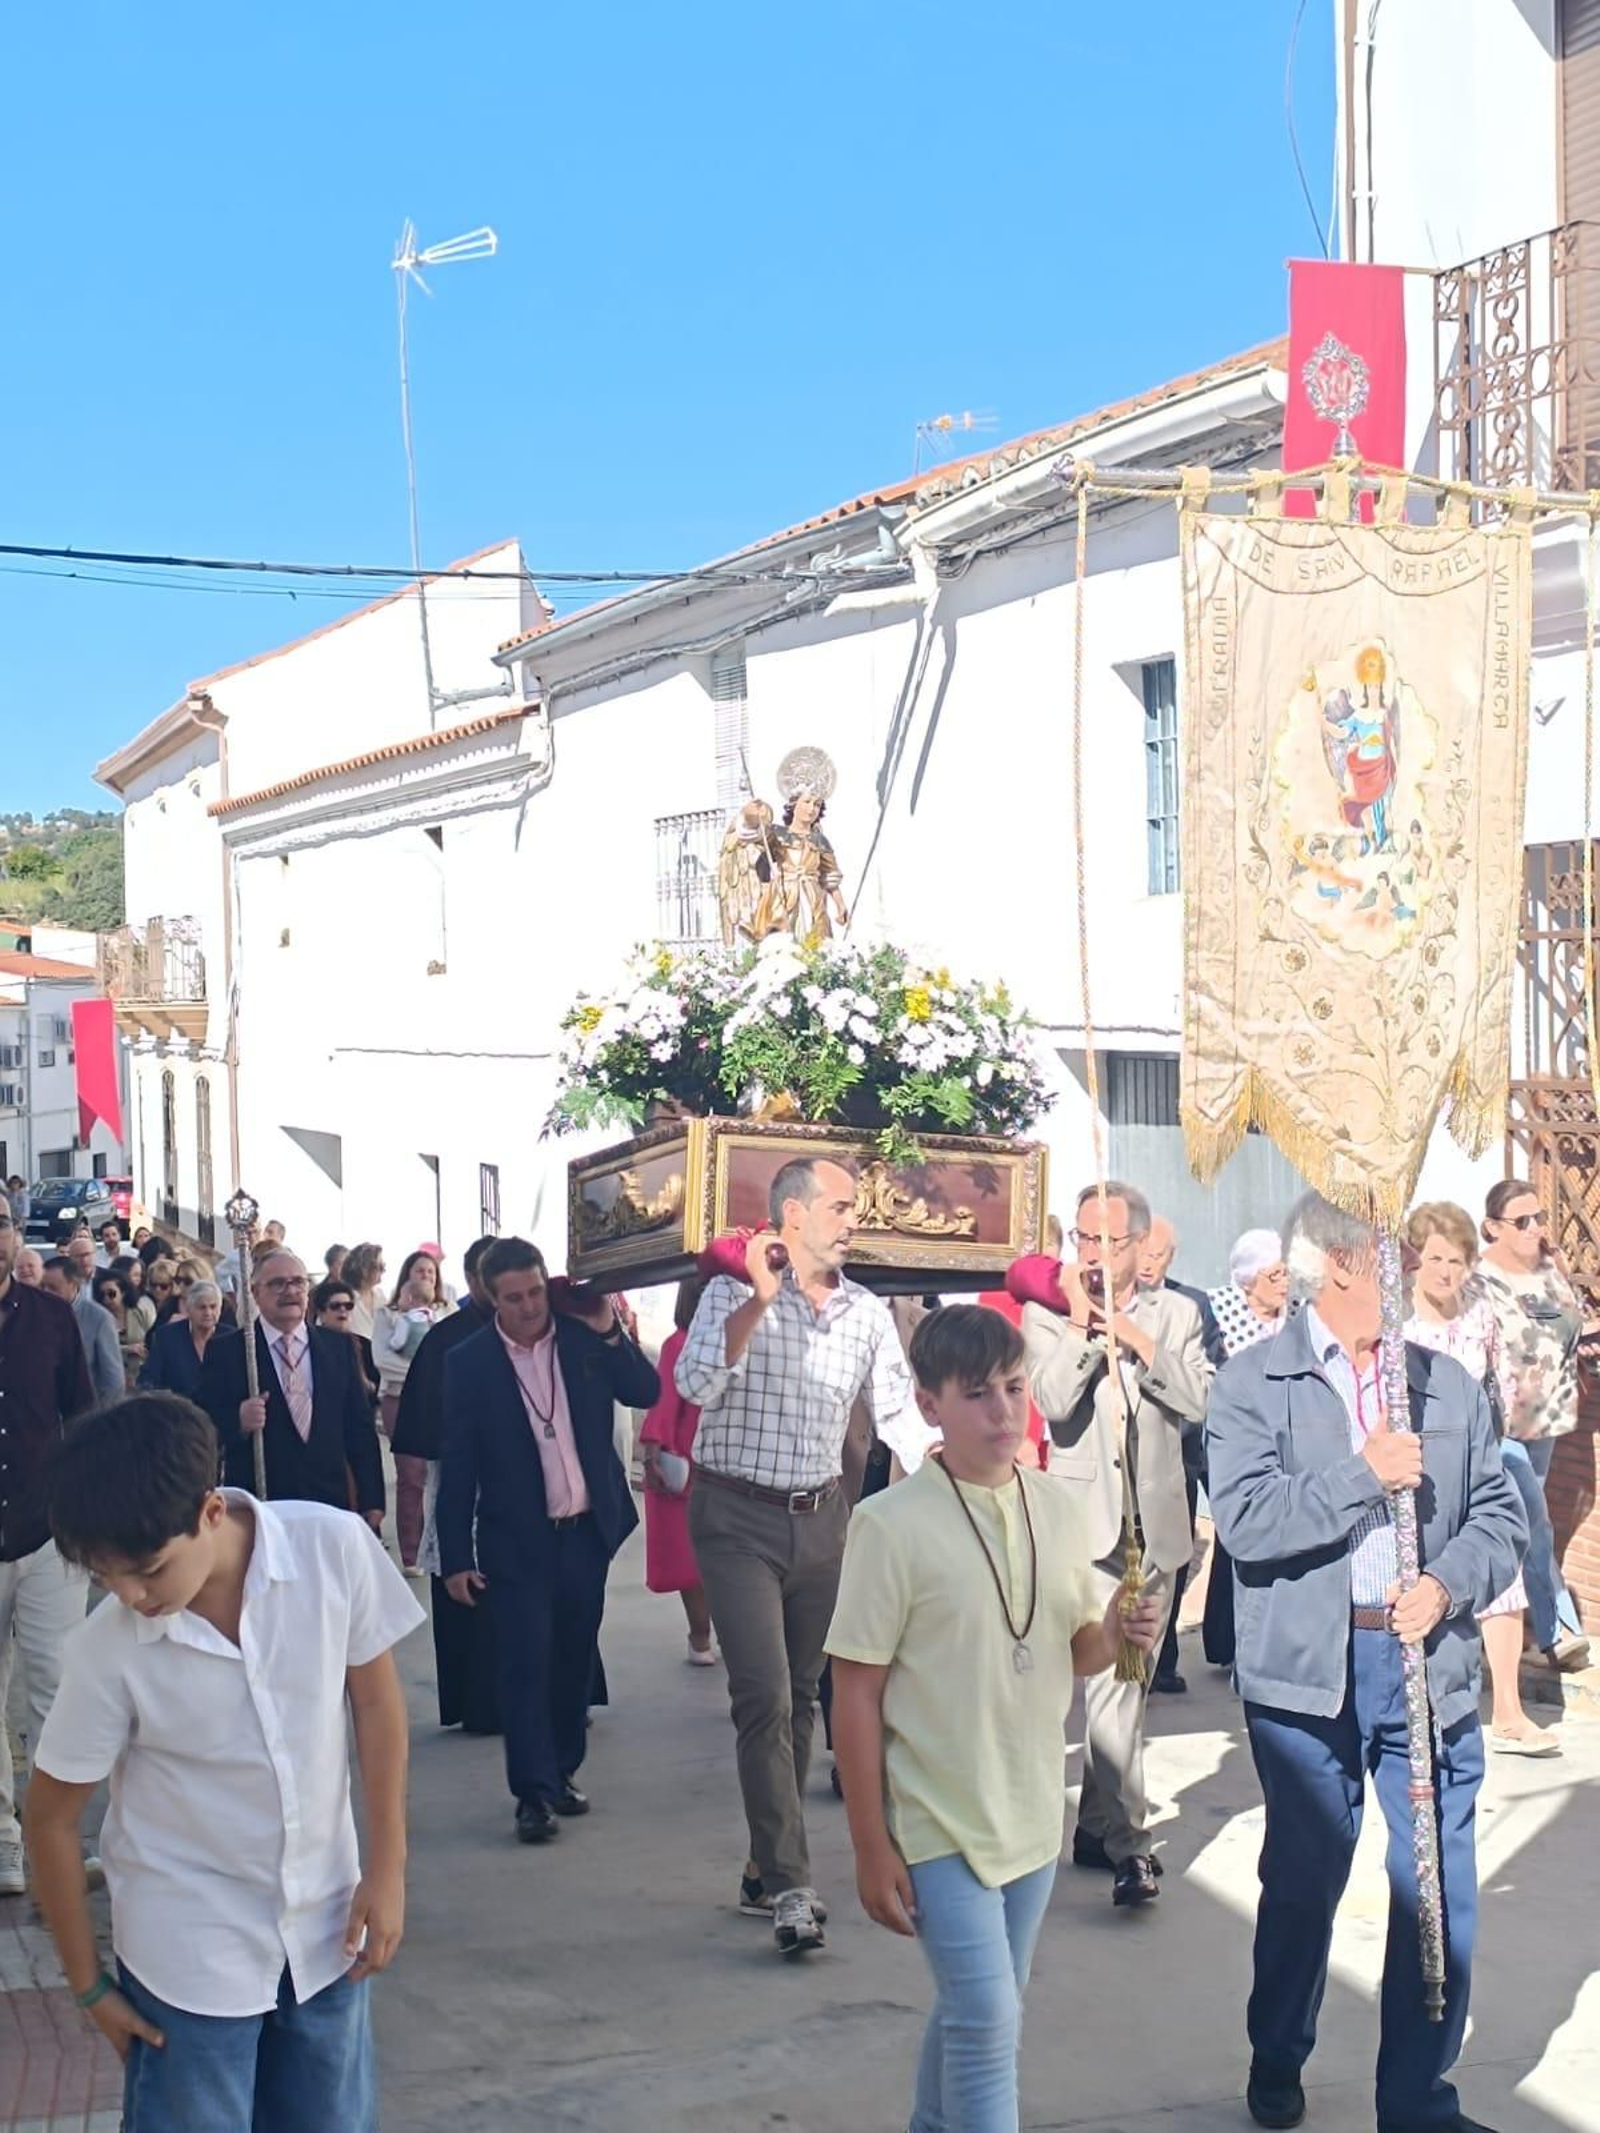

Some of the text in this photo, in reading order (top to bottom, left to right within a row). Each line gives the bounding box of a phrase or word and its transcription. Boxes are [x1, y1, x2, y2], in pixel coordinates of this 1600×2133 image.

[1249, 543, 1481, 584] DE SAN RAFAEL
